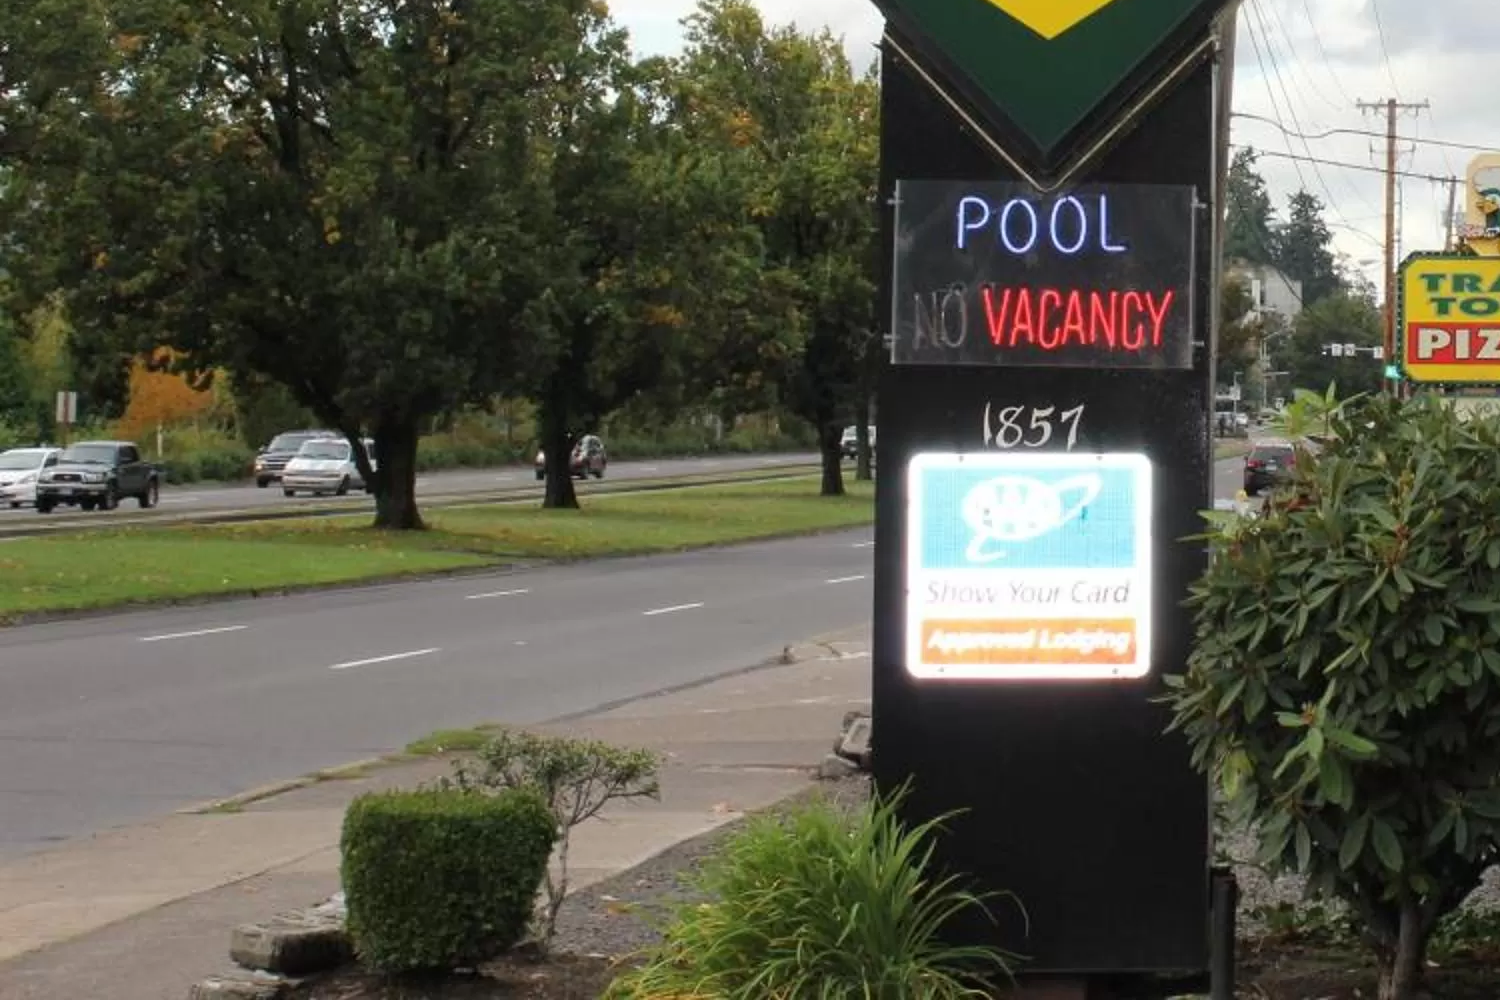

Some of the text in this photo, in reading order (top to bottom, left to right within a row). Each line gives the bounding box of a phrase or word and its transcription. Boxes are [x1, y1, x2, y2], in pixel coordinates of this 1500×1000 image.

[956, 195, 1127, 254] POOL
[912, 286, 1174, 350] NO VACANCY
[984, 401, 1085, 452] 1857
[926, 578, 1130, 604] Show Your Card
[927, 627, 1131, 655] Approved Lodging
